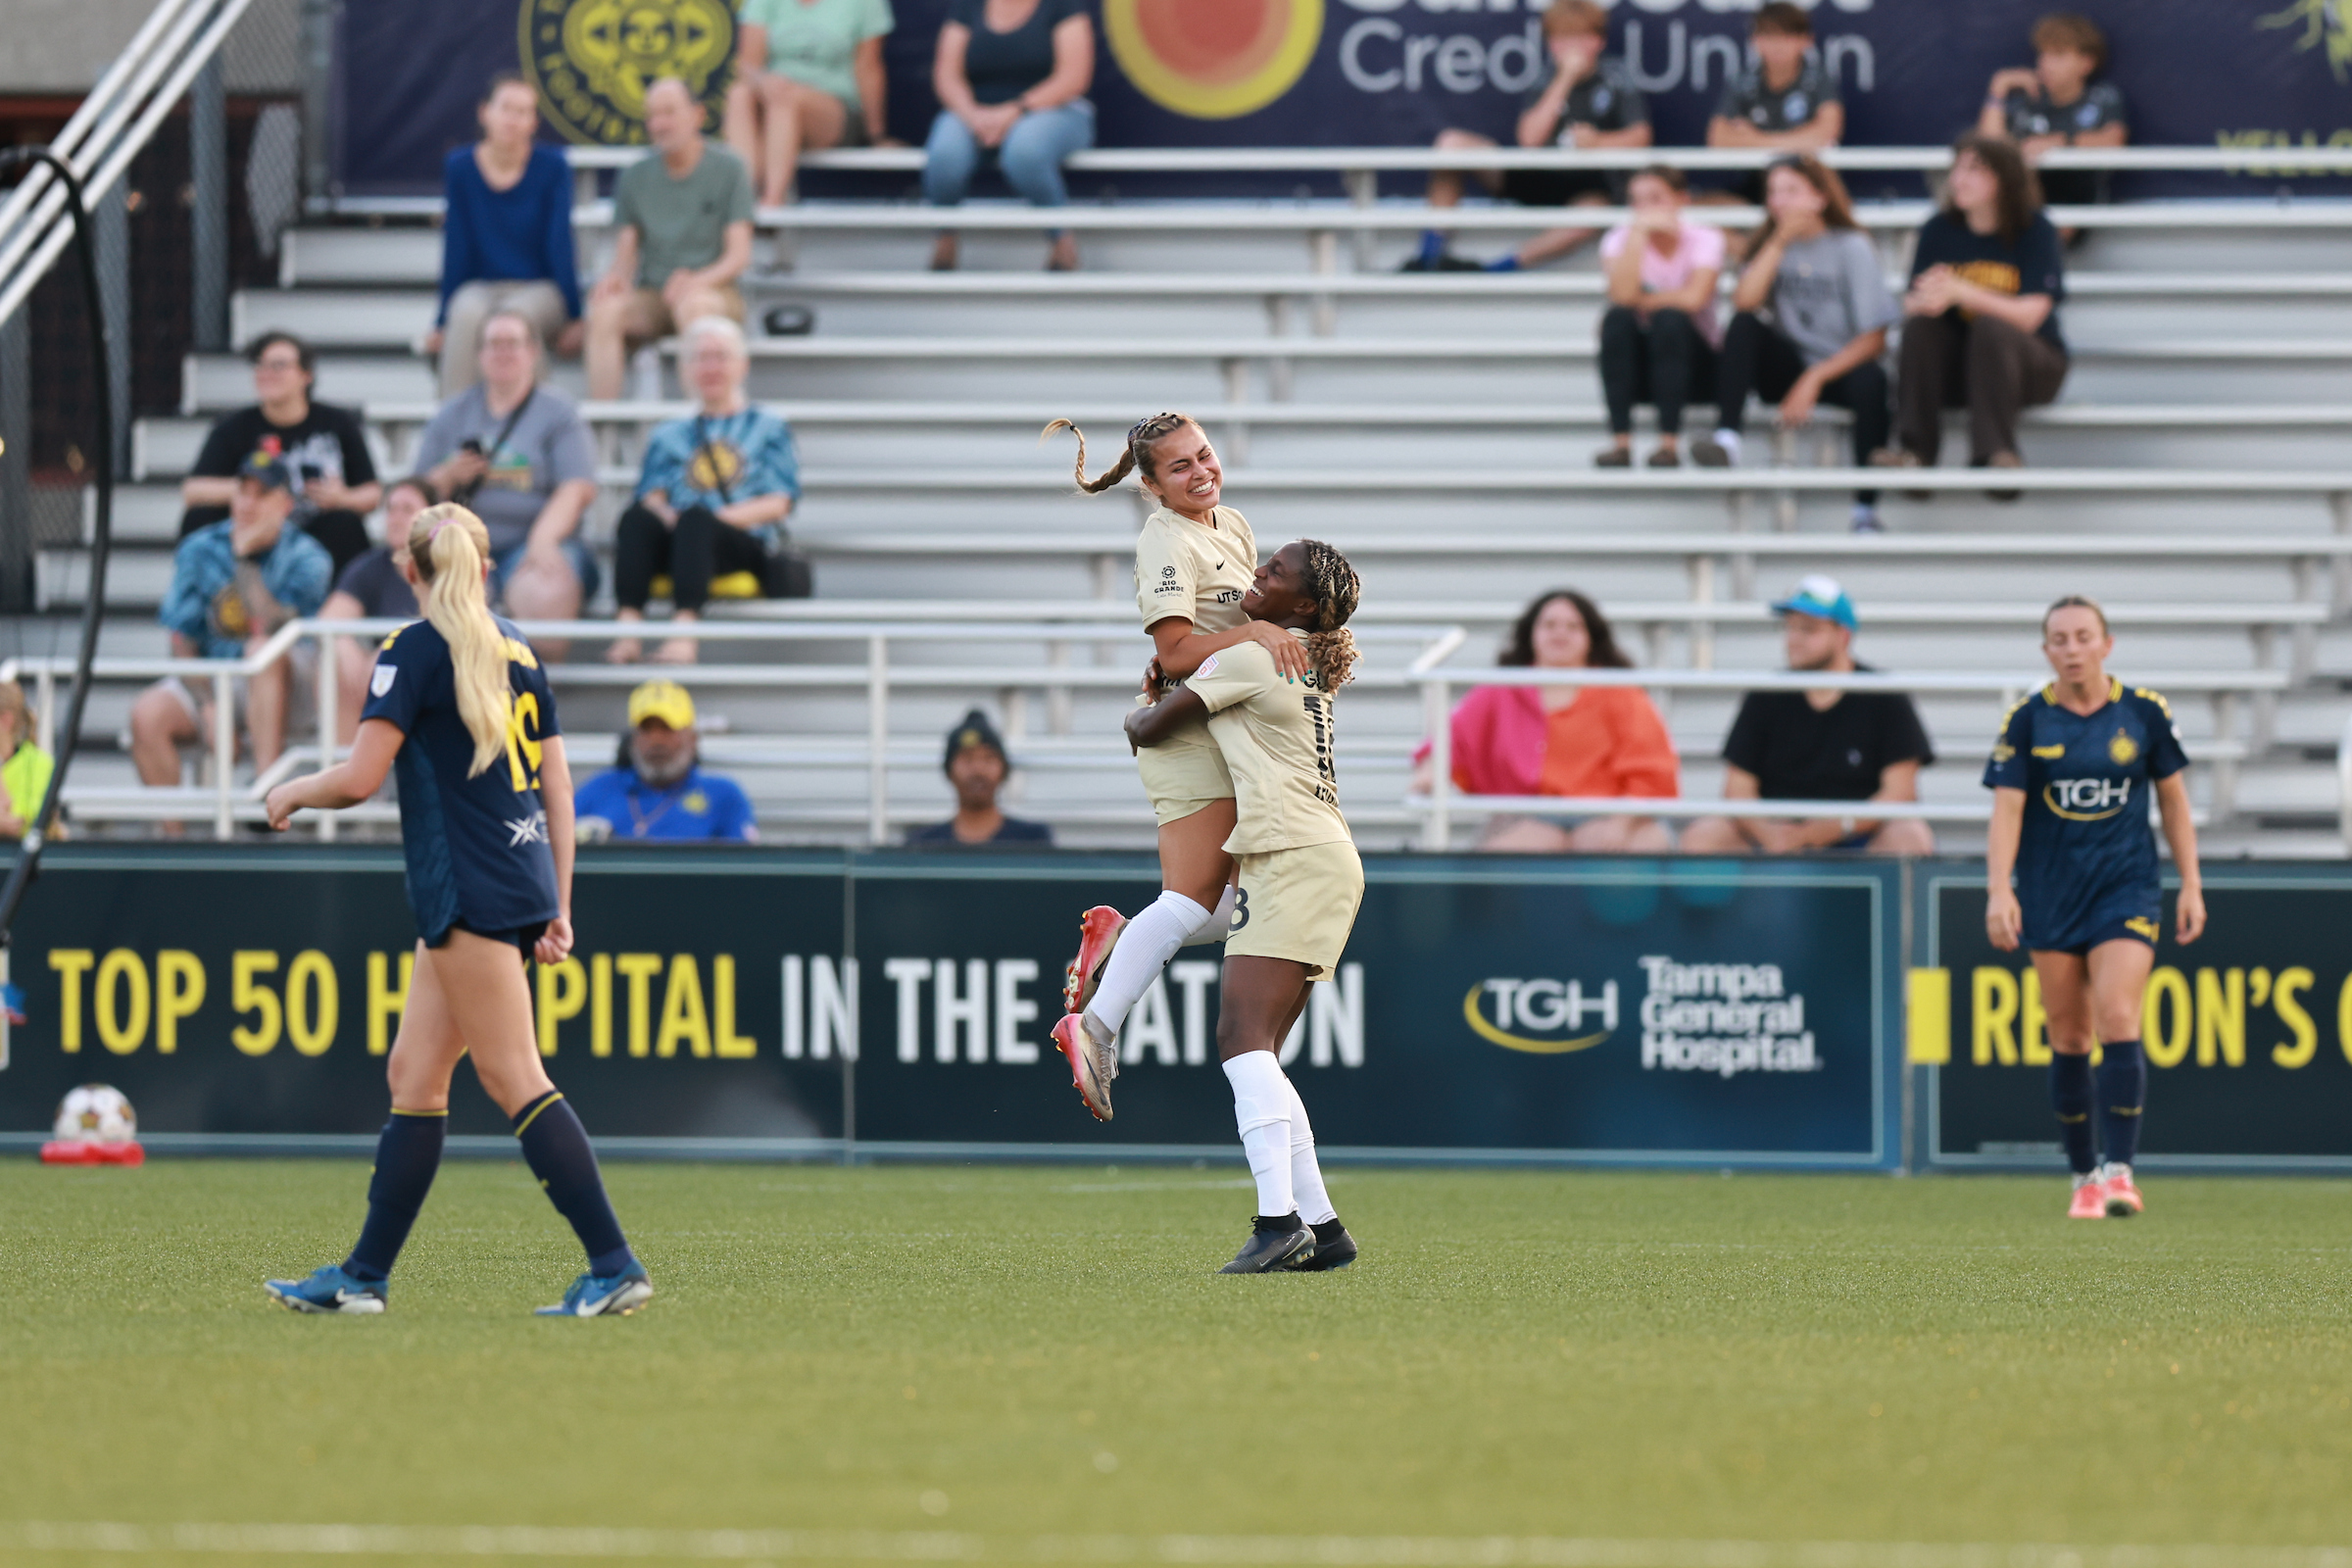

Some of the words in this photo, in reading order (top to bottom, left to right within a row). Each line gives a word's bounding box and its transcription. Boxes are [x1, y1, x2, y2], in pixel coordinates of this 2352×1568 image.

[1340, 17, 1543, 94] Cred
[1624, 19, 1875, 92] Unn
[1154, 585, 1185, 594] GRANDE
[2052, 777, 2132, 809] TGH
[1639, 955, 1783, 999] Tampa
[49, 948, 206, 1055] TOP
[230, 949, 339, 1056] 50
[367, 950, 758, 1059] HPITAL
[781, 955, 860, 1062] IN
[884, 957, 1040, 1065] THE
[1066, 959, 1365, 1068] ATN
[1484, 978, 1619, 1032] TGH
[1641, 994, 1804, 1034] General
[1972, 965, 2319, 1069] REON'S
